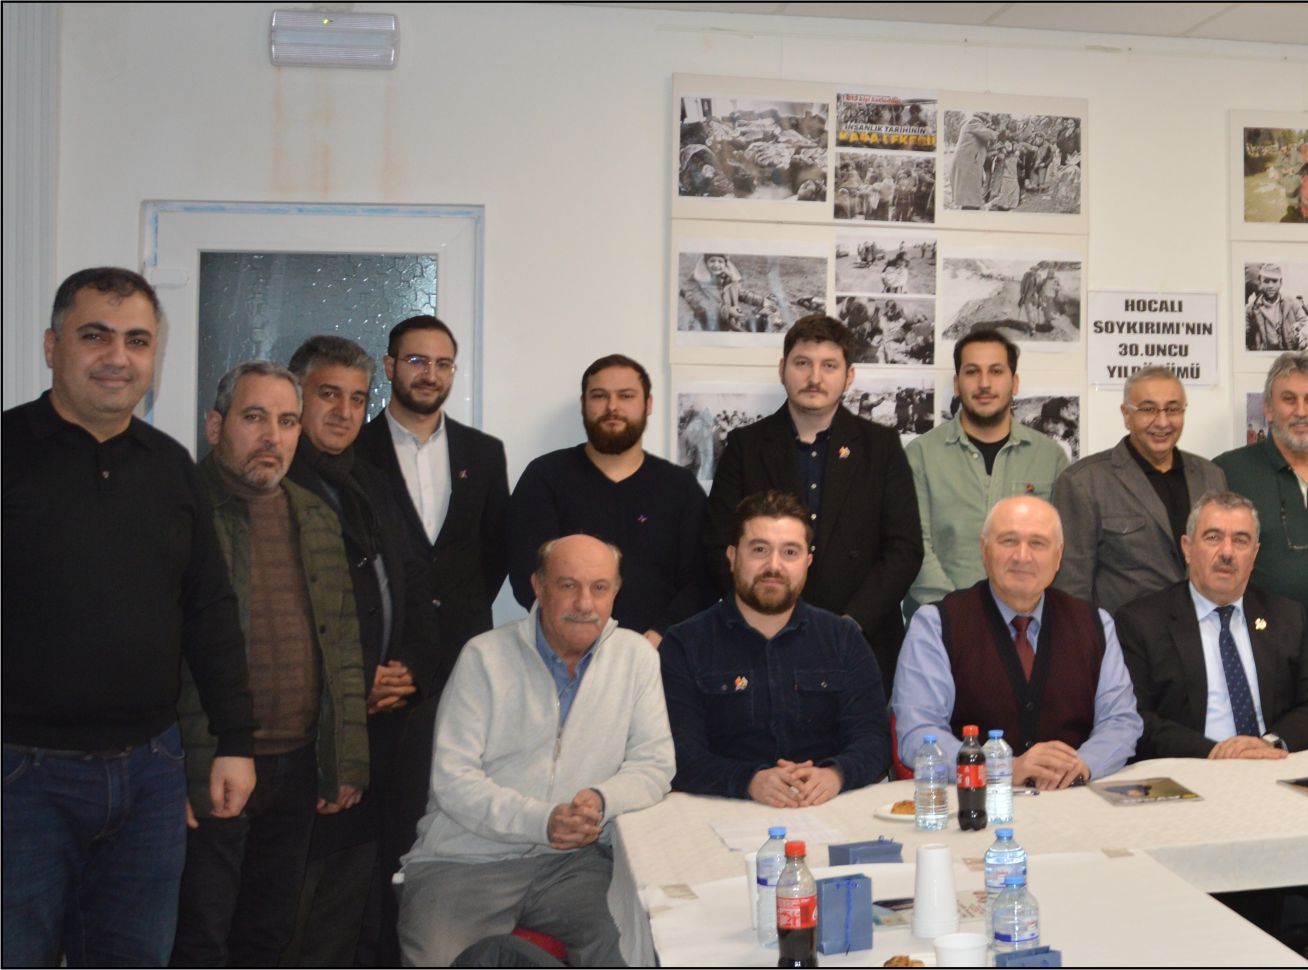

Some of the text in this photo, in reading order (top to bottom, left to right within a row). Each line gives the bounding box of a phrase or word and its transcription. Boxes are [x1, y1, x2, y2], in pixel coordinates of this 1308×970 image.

[1124, 299, 1184, 313] HOCALI
[1093, 321, 1213, 335] SOYKIRIMI'NIN
[1118, 343, 1189, 357] 30.UNCU
